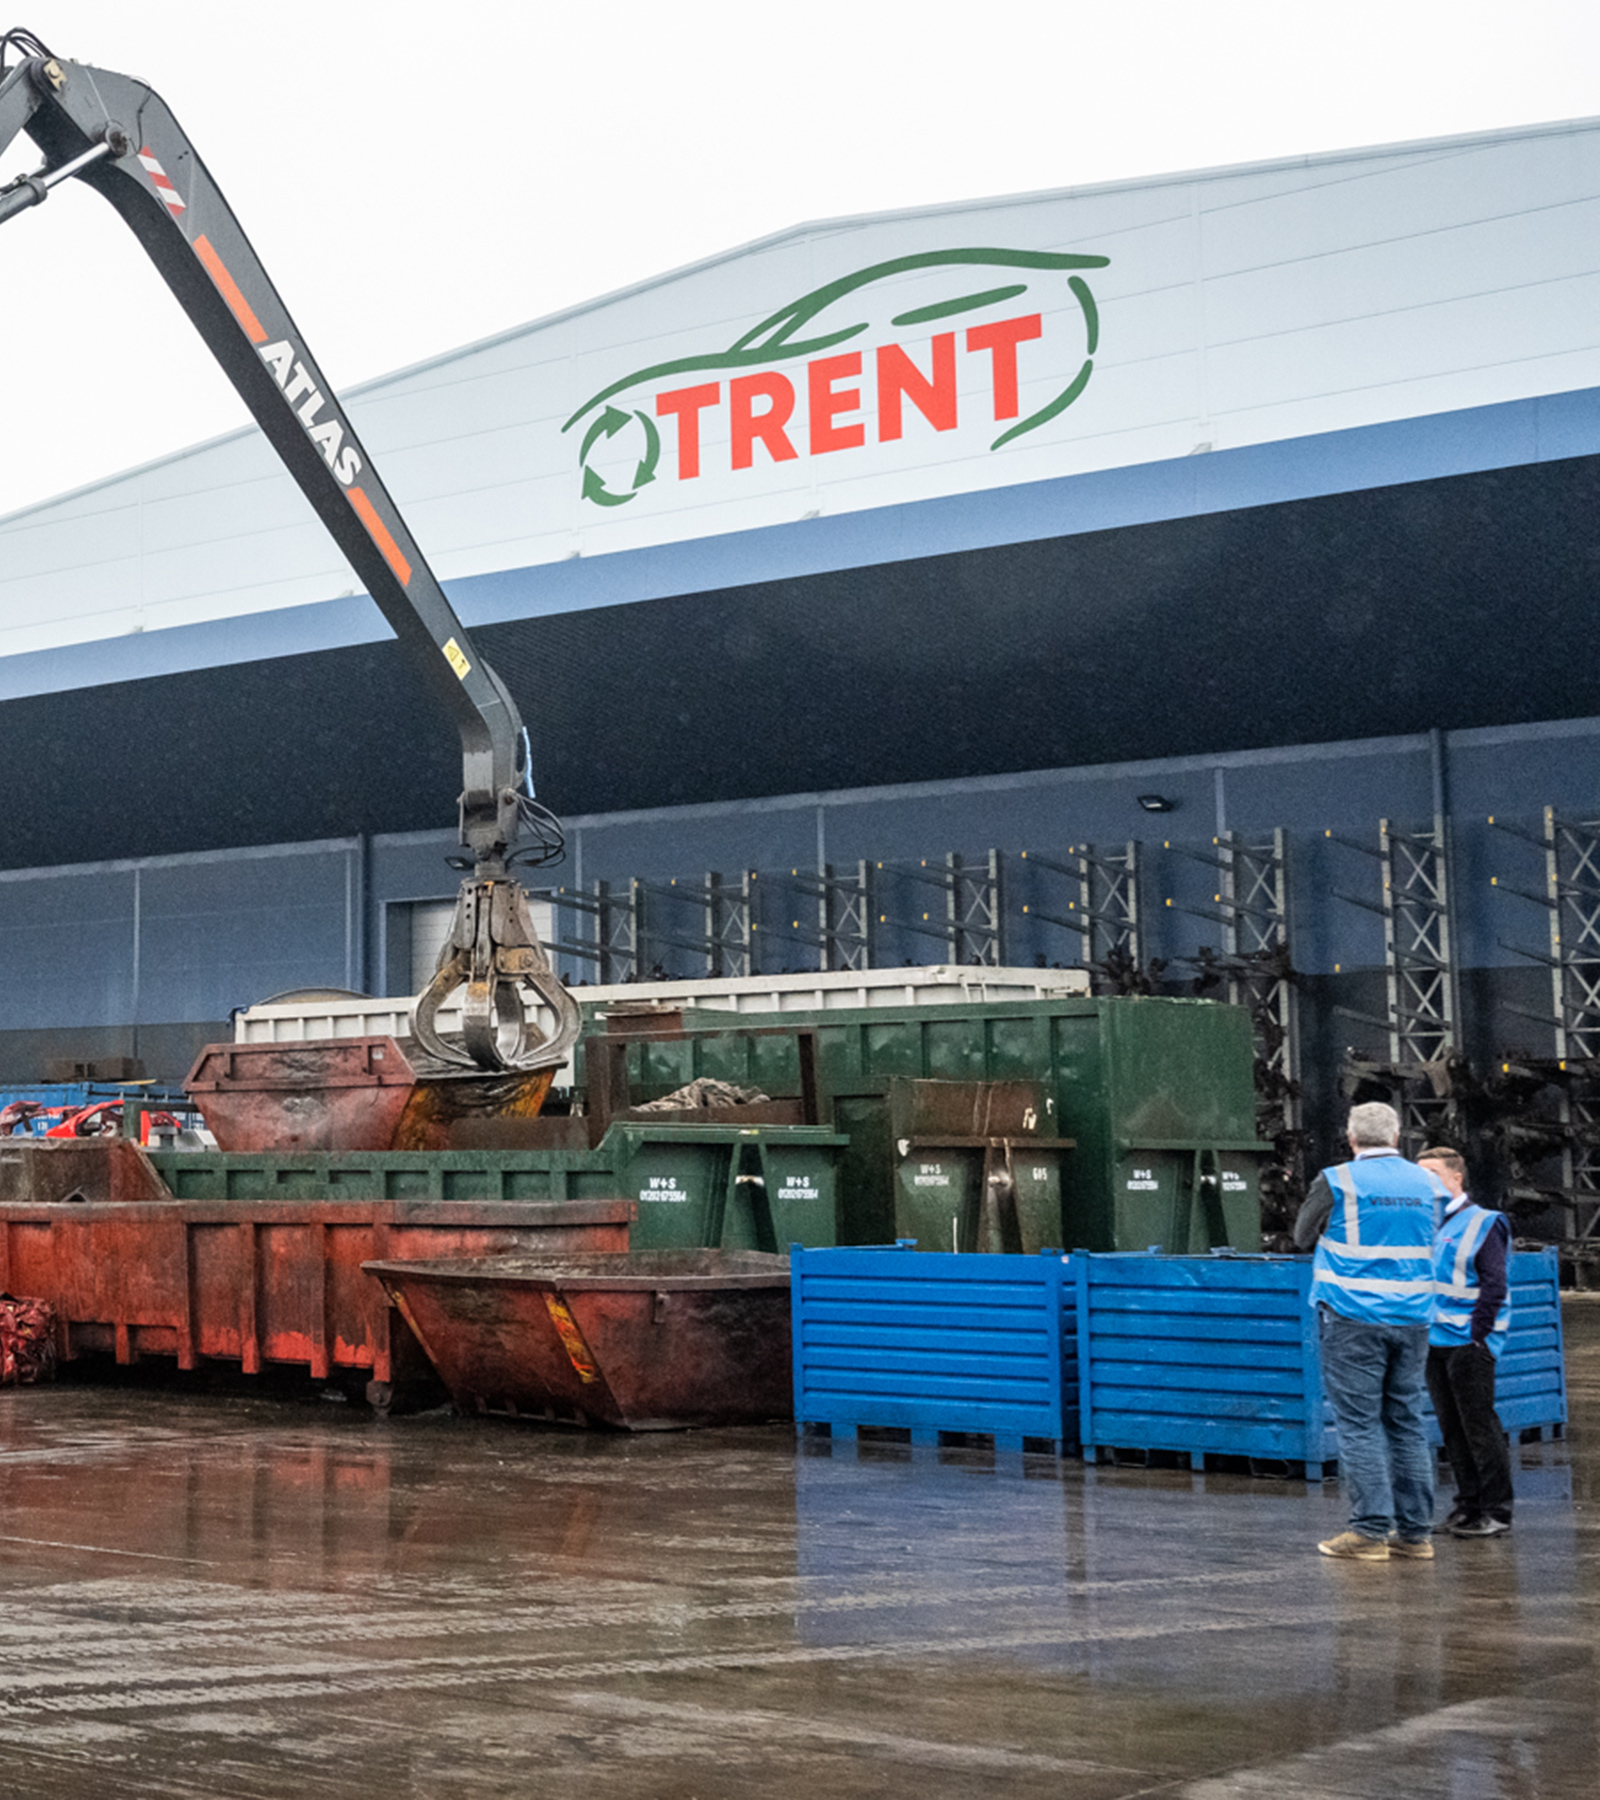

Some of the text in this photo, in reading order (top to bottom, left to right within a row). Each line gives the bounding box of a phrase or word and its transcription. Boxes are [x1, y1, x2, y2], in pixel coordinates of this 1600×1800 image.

[258, 340, 362, 486] ATLAS
[656, 314, 1042, 480] TRENT
[1370, 1197, 1422, 1207] VISITOR
